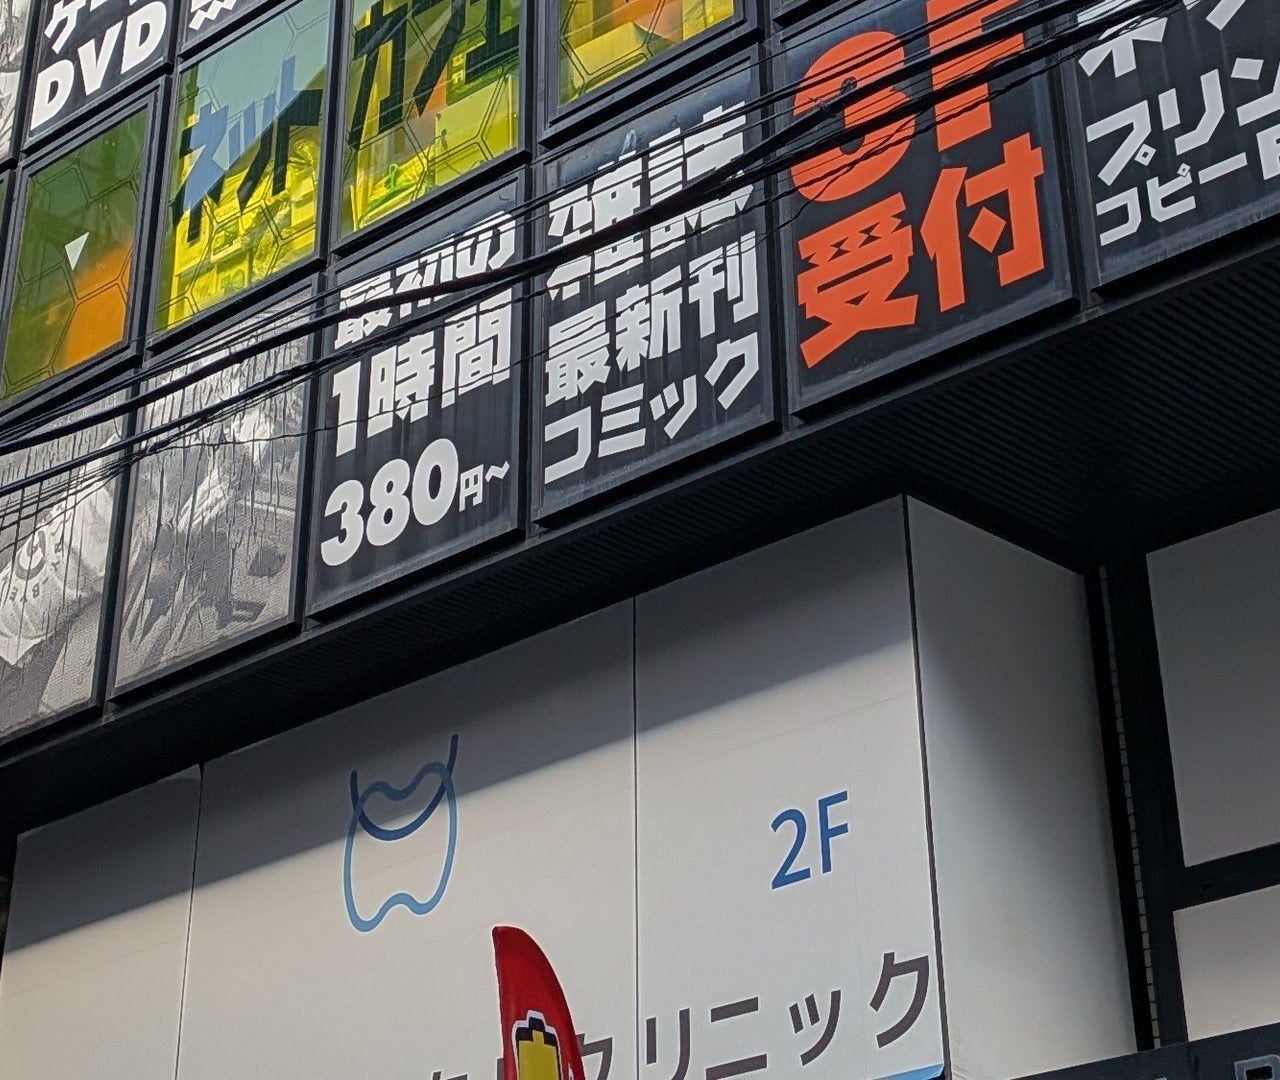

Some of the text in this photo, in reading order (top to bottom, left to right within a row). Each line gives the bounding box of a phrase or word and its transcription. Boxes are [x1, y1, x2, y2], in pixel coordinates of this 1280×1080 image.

[31, 1, 166, 130] DVD
[334, 210, 516, 350] 最初の
[545, 230, 759, 407] 最新刊
[797, 133, 1047, 369] 受付
[332, 288, 513, 458] 1時間
[544, 332, 759, 485] コミック
[771, 790, 849, 890] 2F
